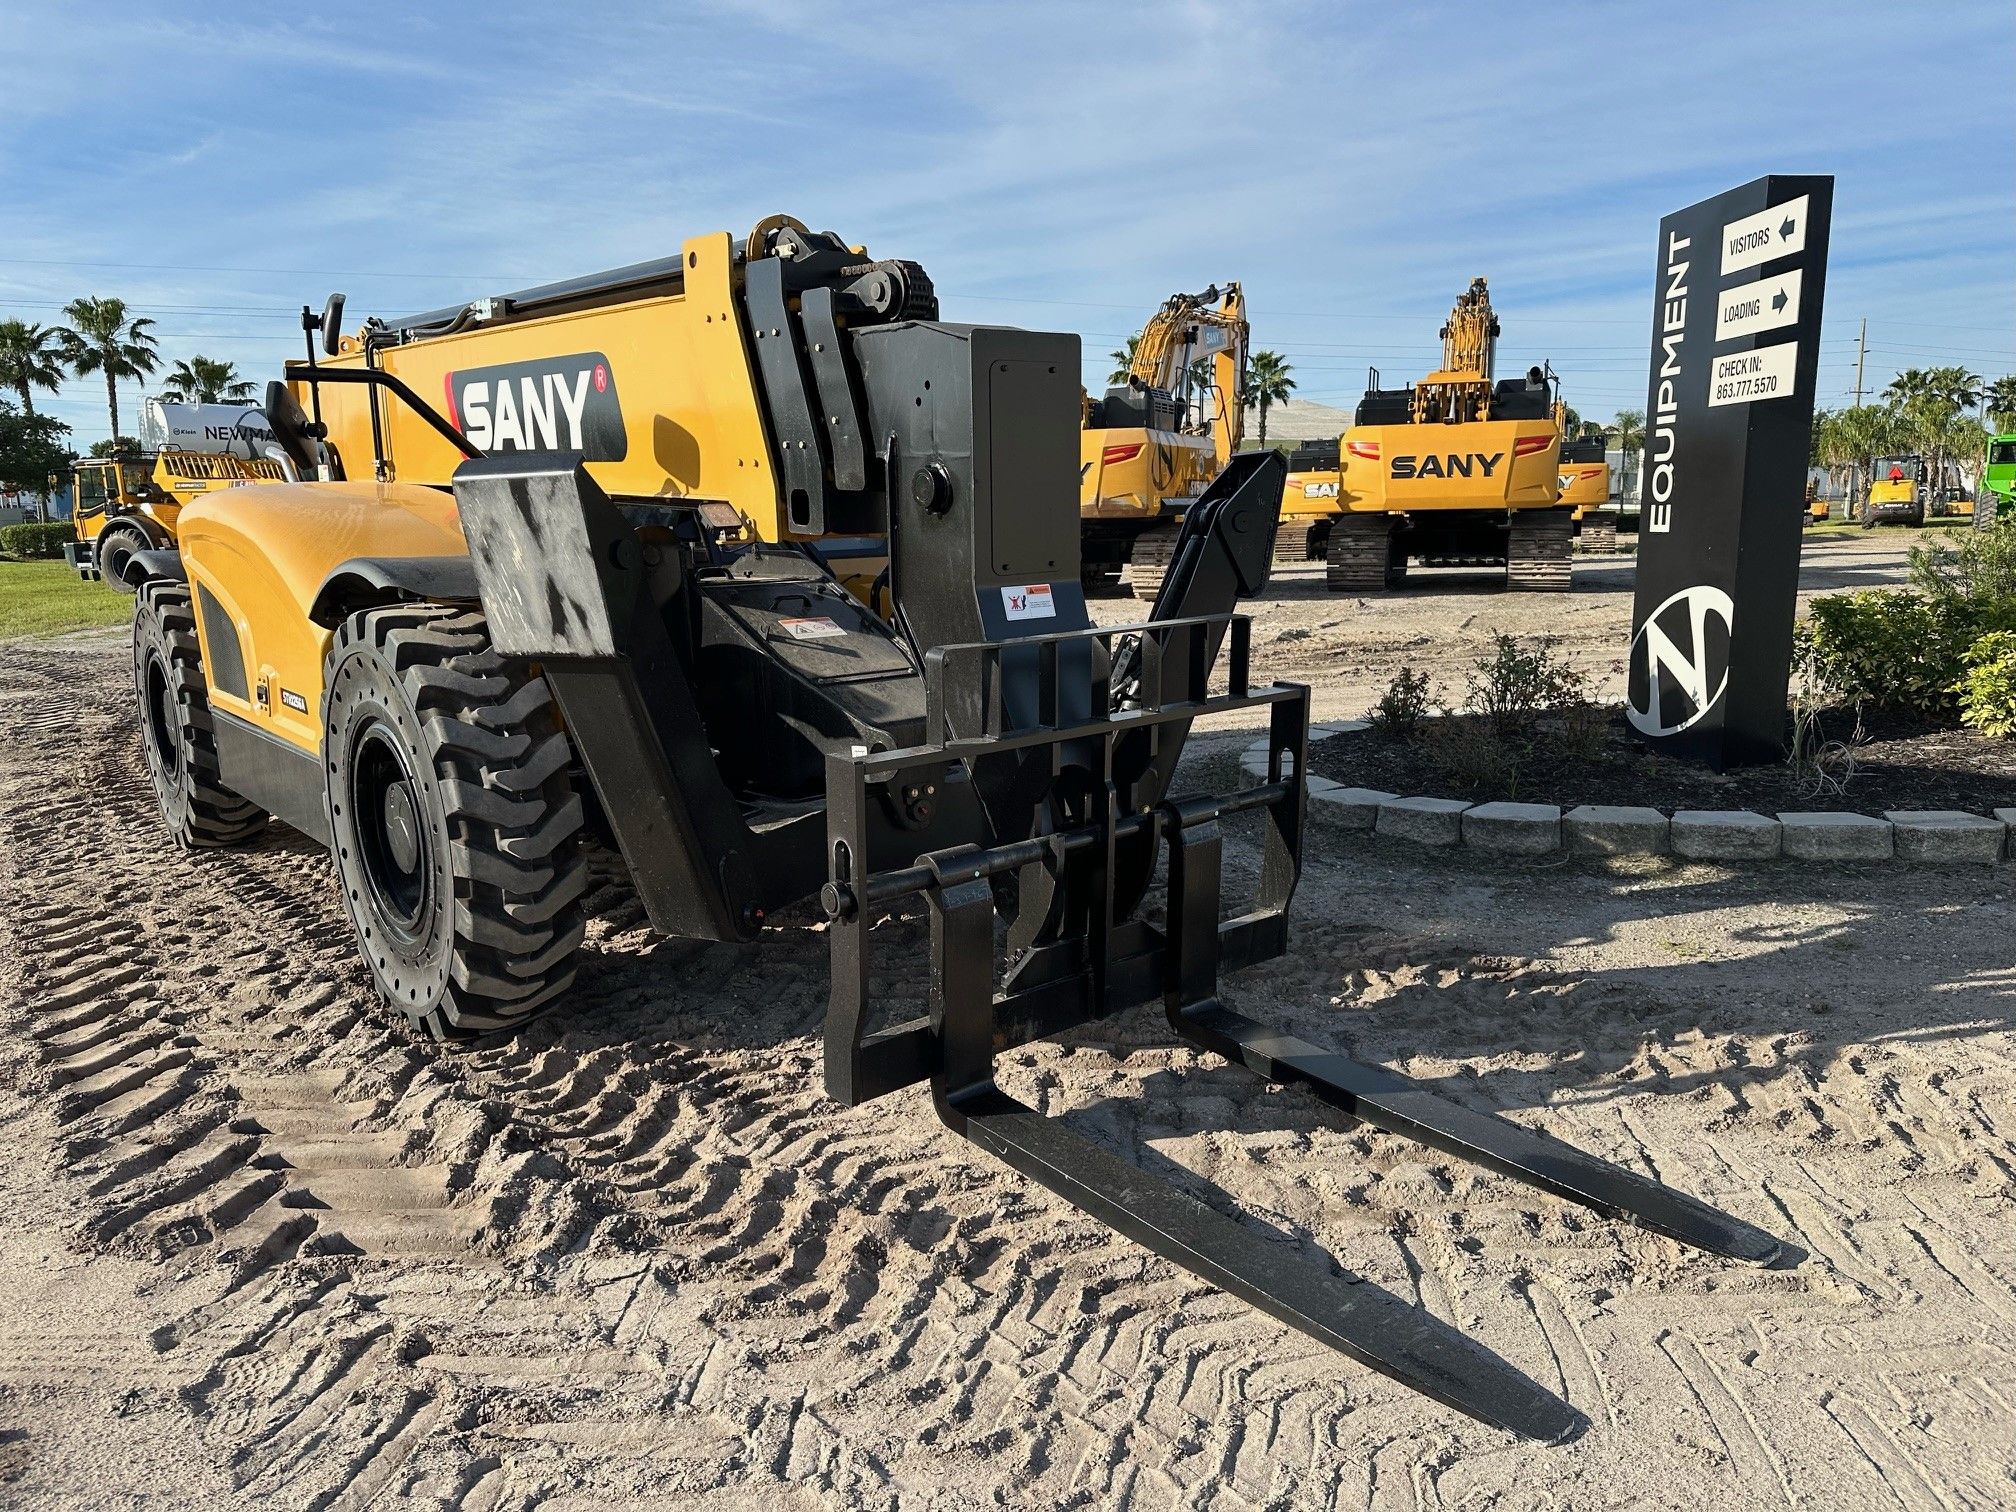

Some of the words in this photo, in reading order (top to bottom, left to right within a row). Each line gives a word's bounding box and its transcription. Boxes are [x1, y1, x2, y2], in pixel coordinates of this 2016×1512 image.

[1730, 227, 1770, 256] VISITORS
[1724, 299, 1760, 324] LOADING
[1719, 357, 1748, 379] CHECK
[1749, 355, 1762, 374] IN:
[1649, 231, 1691, 533] EQUIPMENT
[1717, 375, 1777, 400] 863.777.5570
[463, 370, 591, 450] SANY
[205, 426, 278, 442] NEWMA
[1391, 453, 1505, 479] SANY
[1304, 483, 1340, 498] SAN
